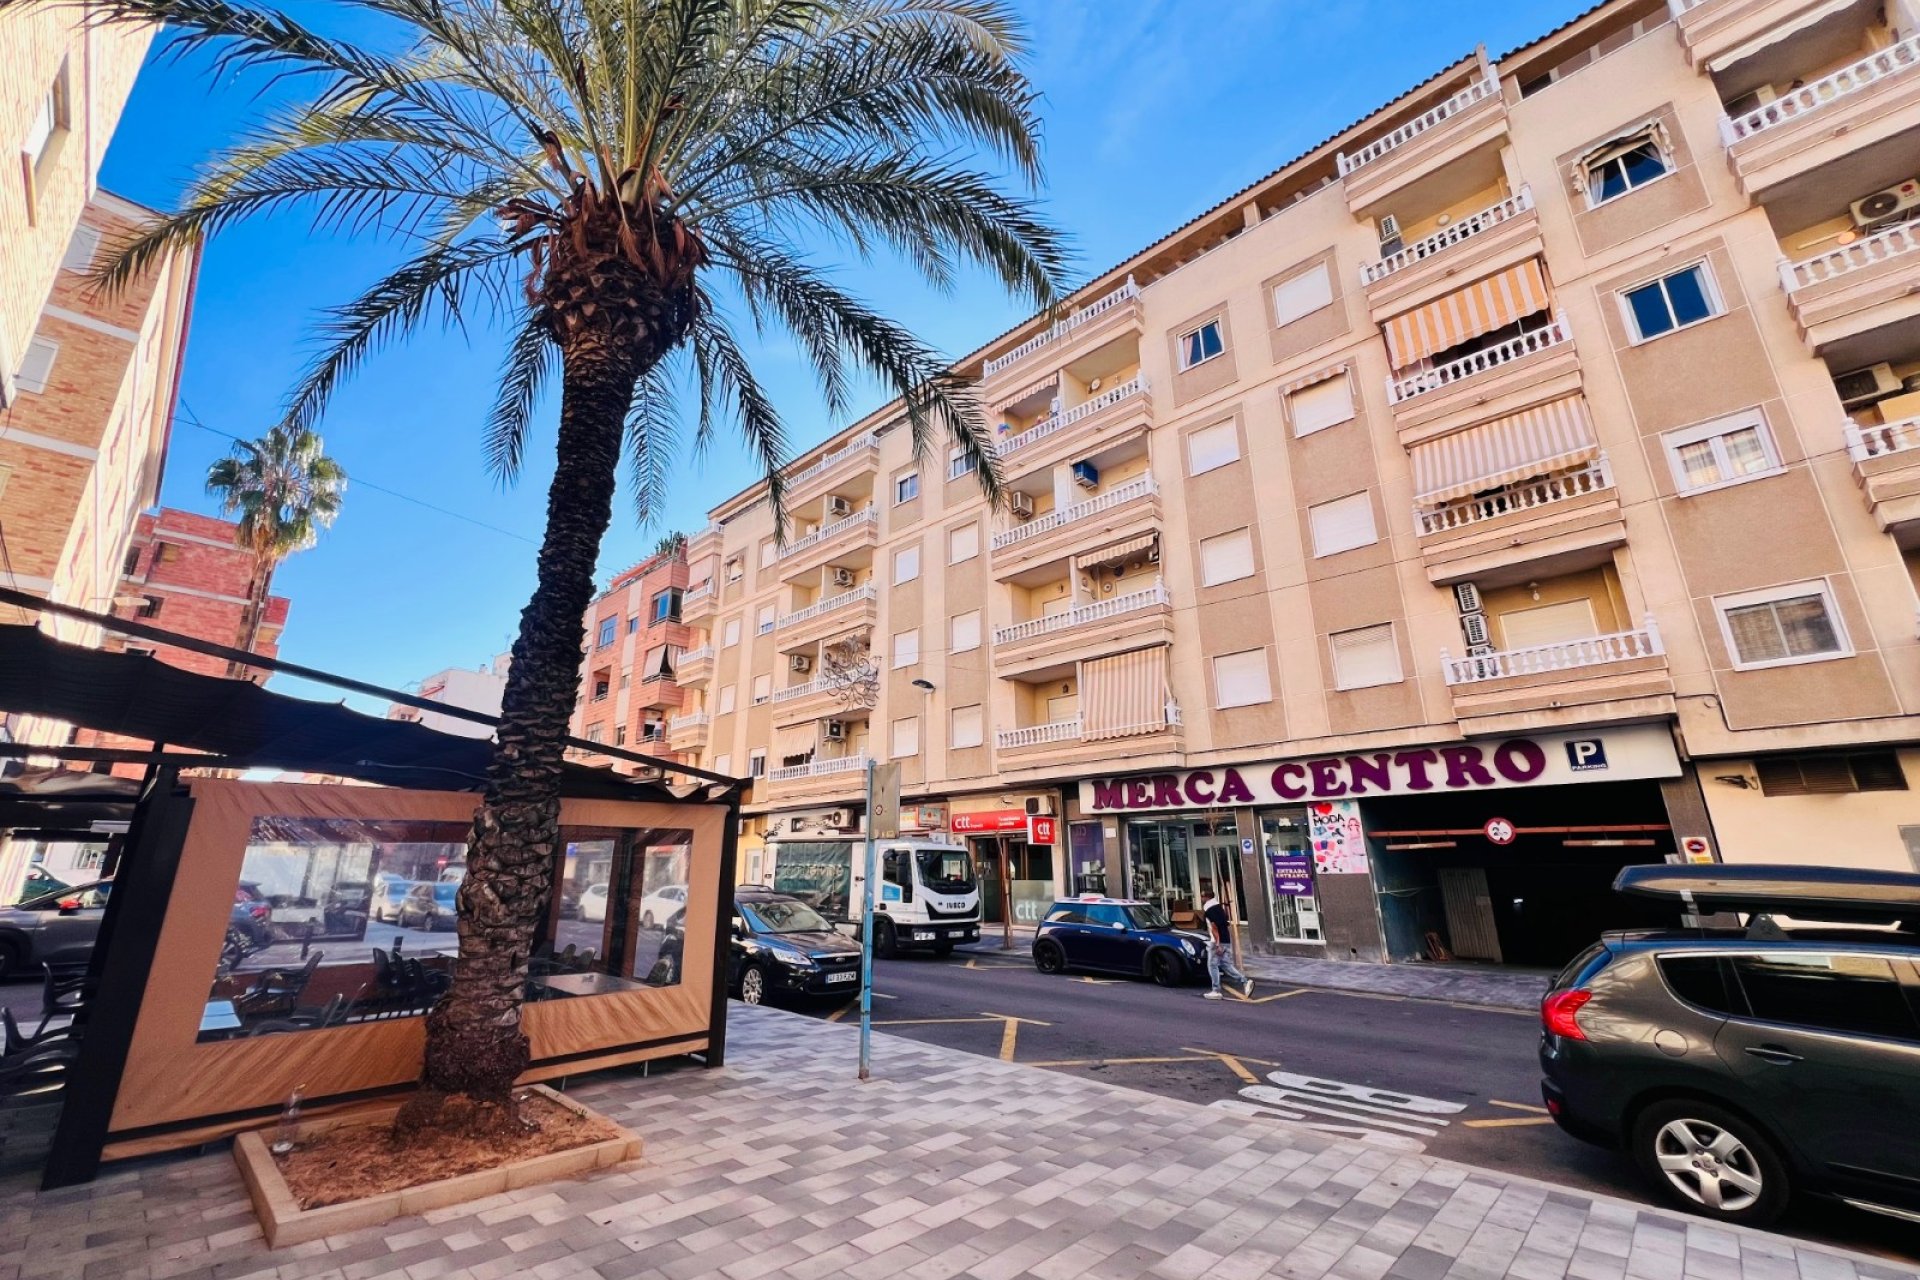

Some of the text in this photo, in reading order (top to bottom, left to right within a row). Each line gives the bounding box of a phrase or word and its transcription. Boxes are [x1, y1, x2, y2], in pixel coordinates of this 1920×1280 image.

[1574, 741, 1597, 765] P
[1571, 763, 1608, 771] PARKING
[1091, 739, 1547, 811] MERCA CENTRO
[954, 815, 971, 829] ctt
[1313, 813, 1345, 826] MODA
[1037, 821, 1051, 836] ctt
[946, 901, 966, 910] IVECO
[1015, 900, 1038, 921] ctt
